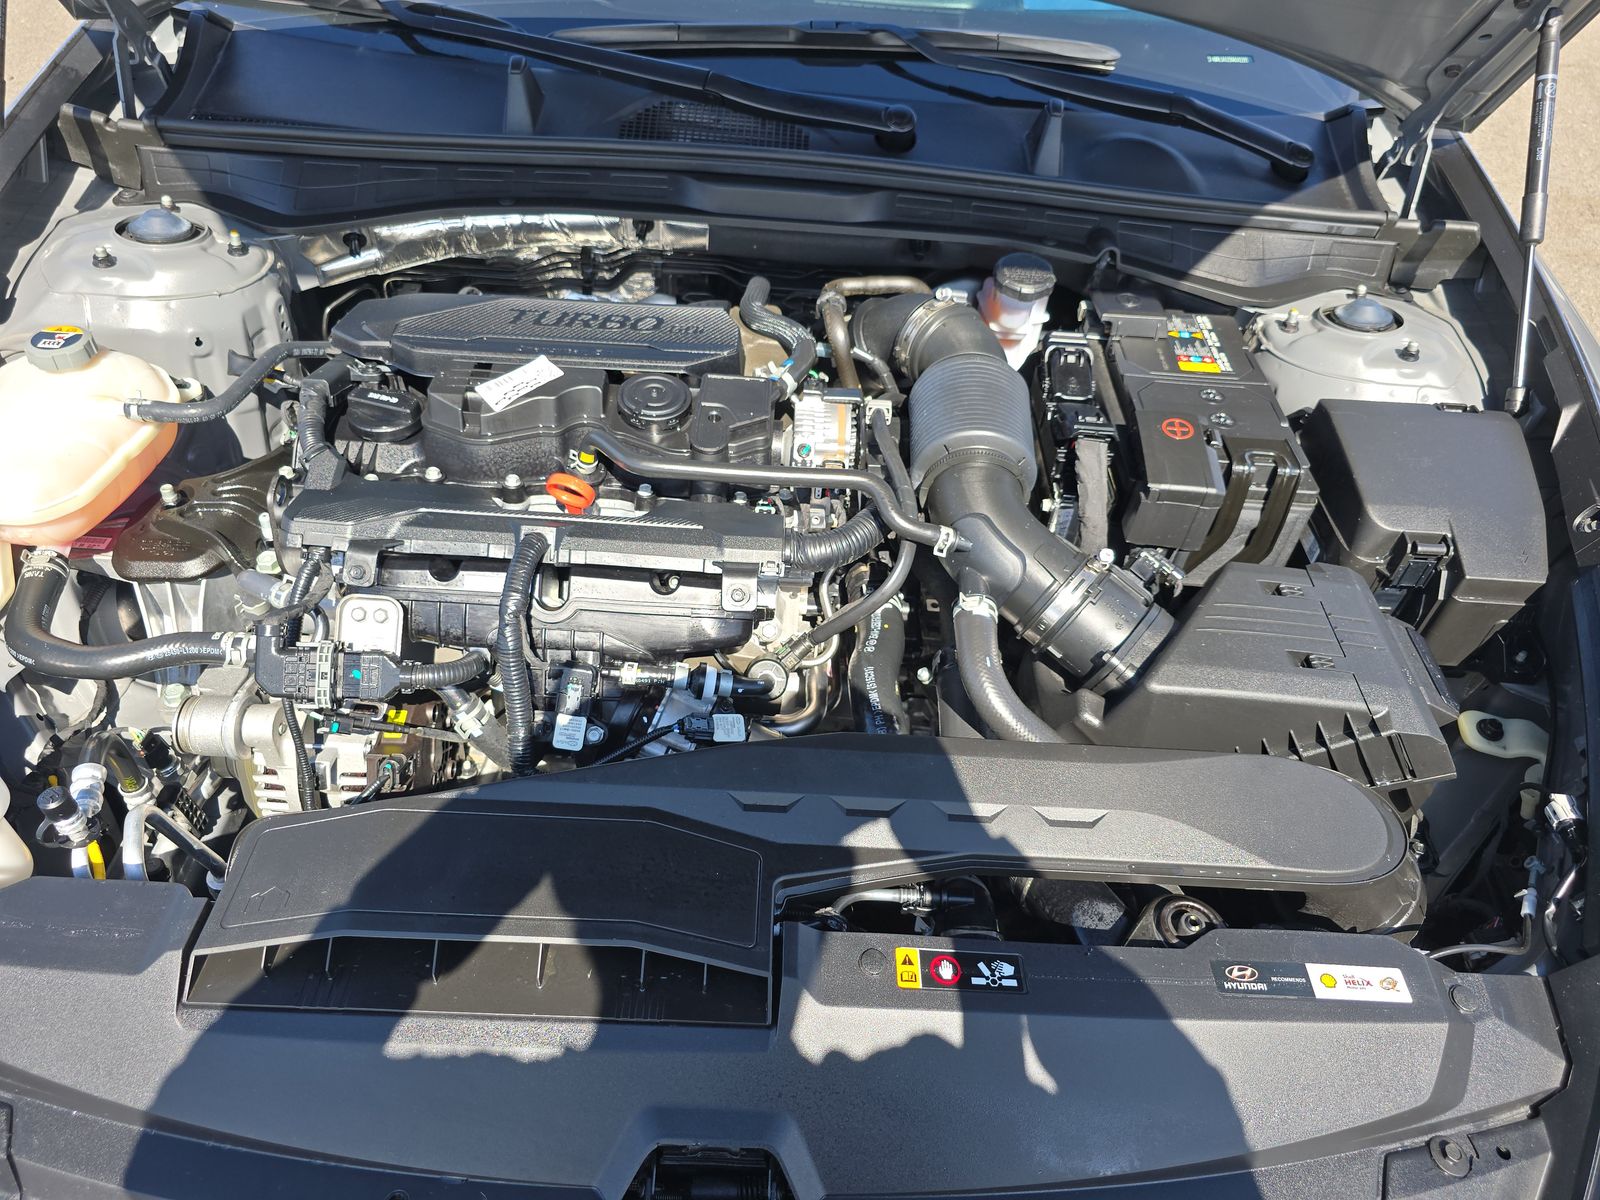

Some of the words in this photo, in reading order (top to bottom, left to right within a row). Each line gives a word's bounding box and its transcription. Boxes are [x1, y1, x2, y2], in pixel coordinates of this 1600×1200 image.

[508, 308, 665, 332] TURBO
[1224, 981, 1268, 991] HYUNDAI
[1344, 978, 1374, 987] HELIX
